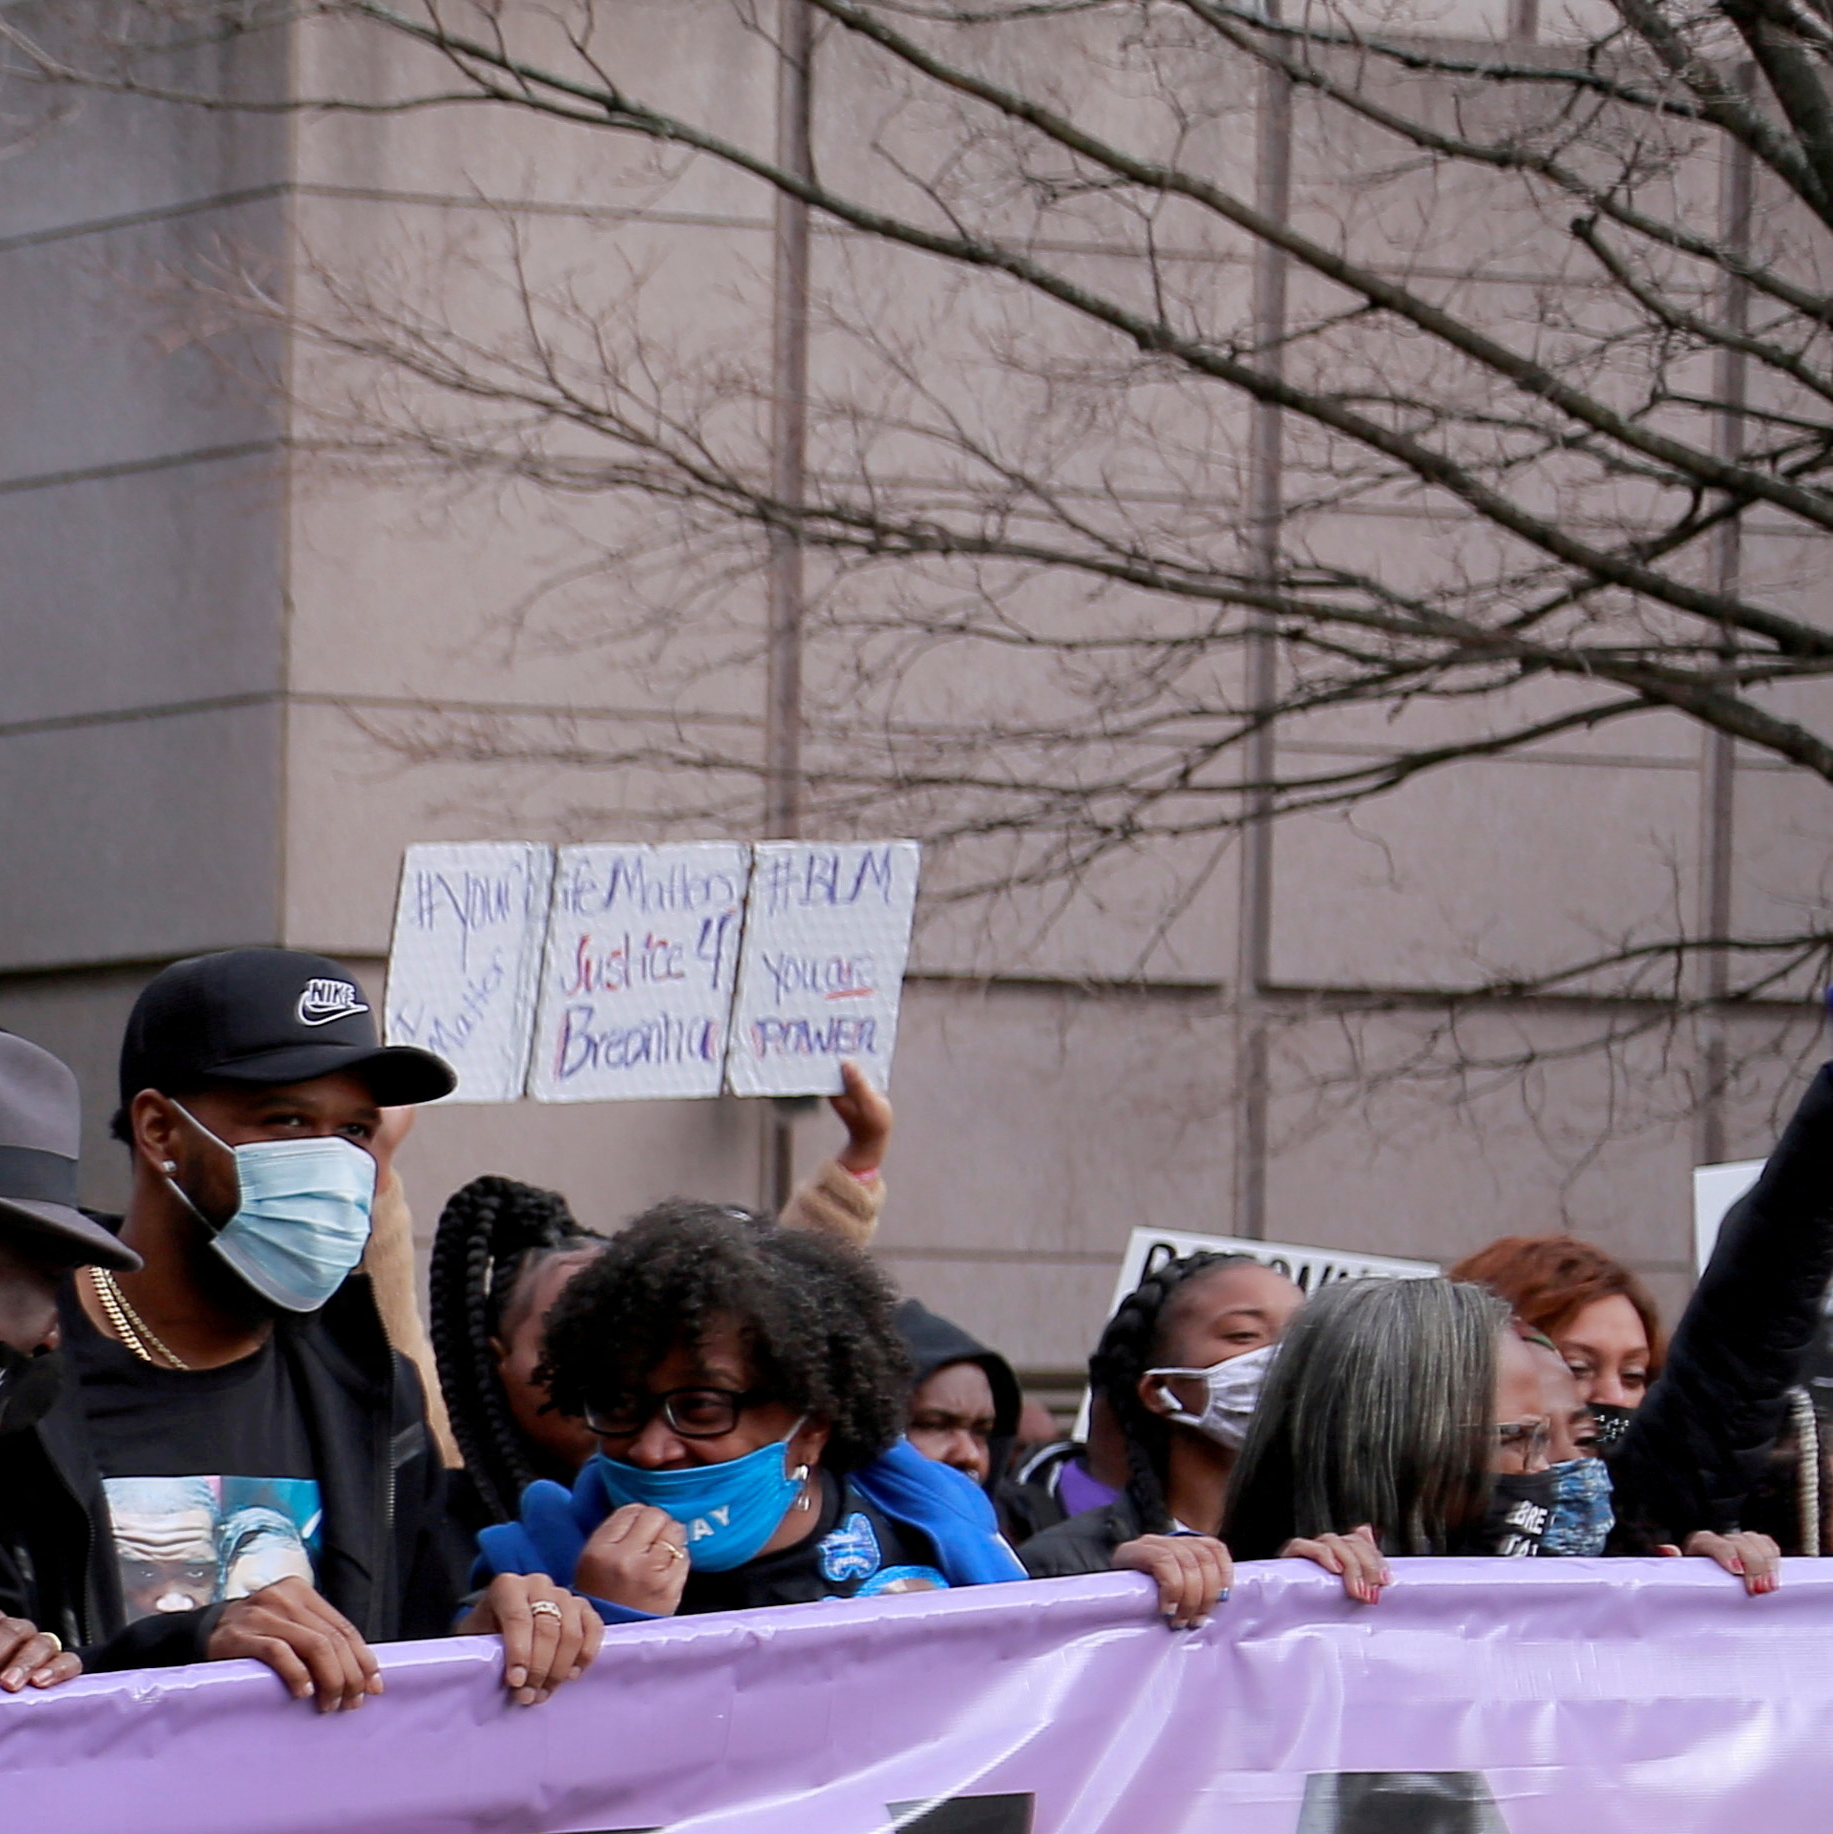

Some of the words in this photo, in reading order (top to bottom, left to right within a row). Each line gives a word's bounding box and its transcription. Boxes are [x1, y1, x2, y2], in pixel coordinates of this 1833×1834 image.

[762, 850, 893, 916] #BLM
[560, 932, 686, 997] Justice
[697, 908, 736, 990] 4
[306, 979, 357, 1007] NIKE
